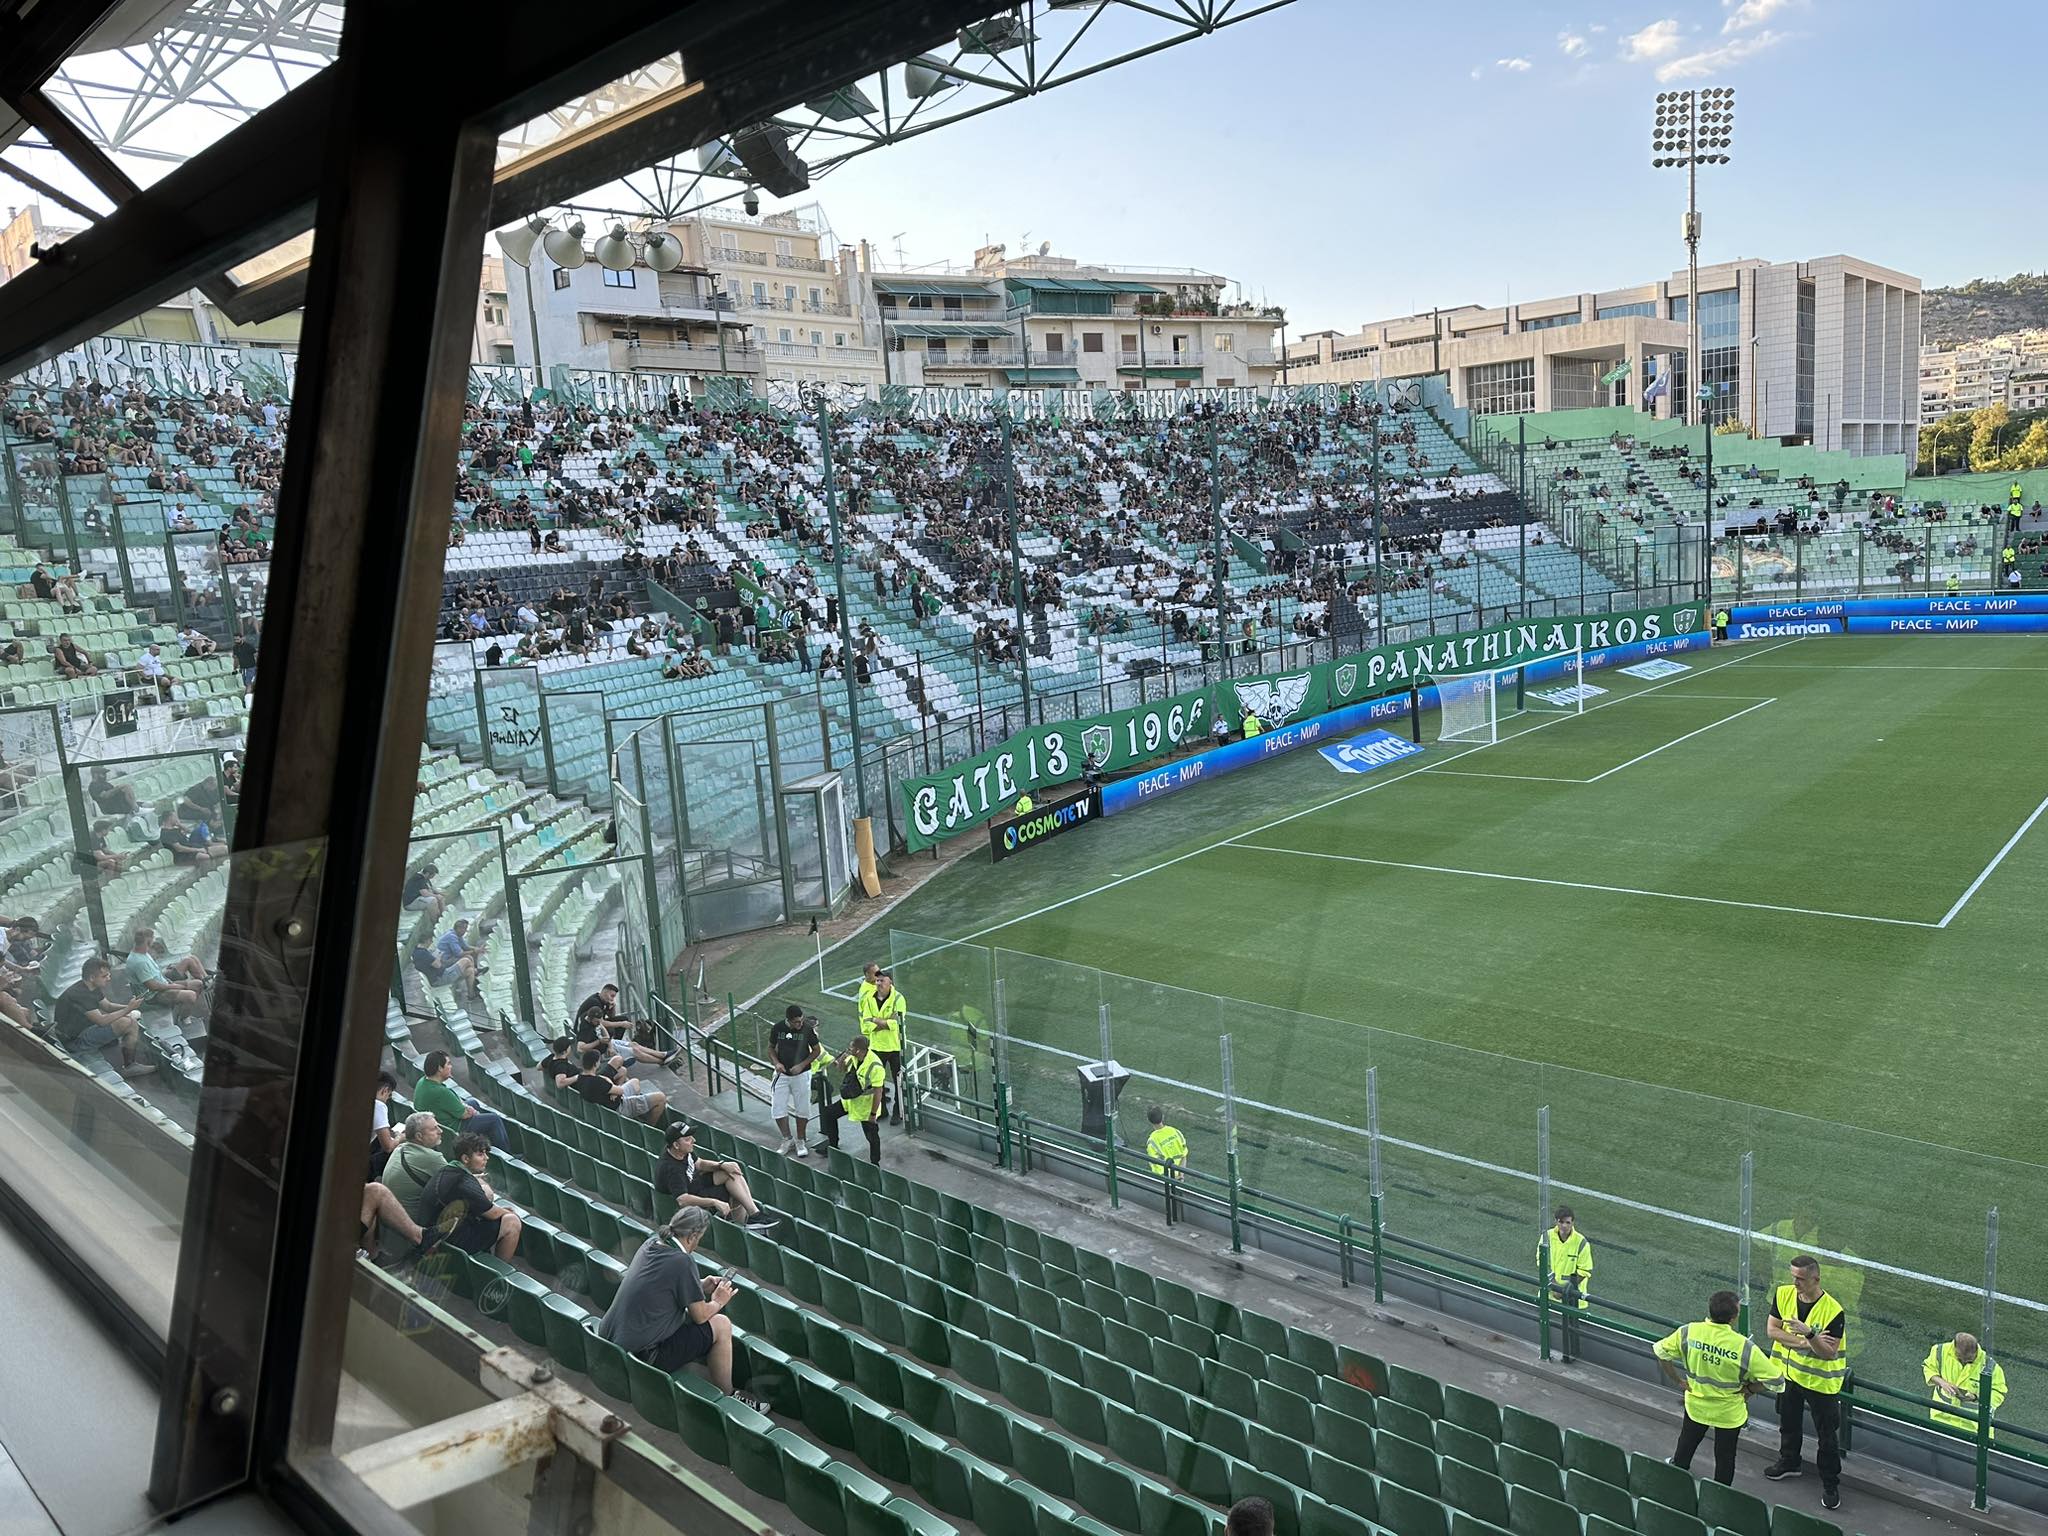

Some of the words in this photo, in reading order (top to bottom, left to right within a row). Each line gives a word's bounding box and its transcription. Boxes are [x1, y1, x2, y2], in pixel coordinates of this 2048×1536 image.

[1769, 607, 1806, 618] PEACE
[1815, 604, 1843, 615] МИР
[1929, 601, 1971, 612] PEACE
[1984, 599, 2018, 611] МИР
[1739, 623, 1831, 639] Stoiximan
[1890, 619, 1932, 630] PEACE
[1945, 618, 1979, 629] МИР
[1367, 614, 1661, 688] PANATHINAIKOS
[1646, 641, 1668, 654] PEACE
[1673, 638, 1690, 650] МИР
[1403, 694, 1423, 710] МР
[1265, 731, 1293, 752] PEACE
[1300, 722, 1320, 741] МИР
[913, 752, 1016, 836] GATE
[1026, 731, 1069, 781] 13
[1138, 772, 1170, 797] PEACE
[1180, 762, 1204, 785] МИР
[1694, 1340, 1738, 1361] BRINKS
[1701, 1353, 1721, 1366] 643
